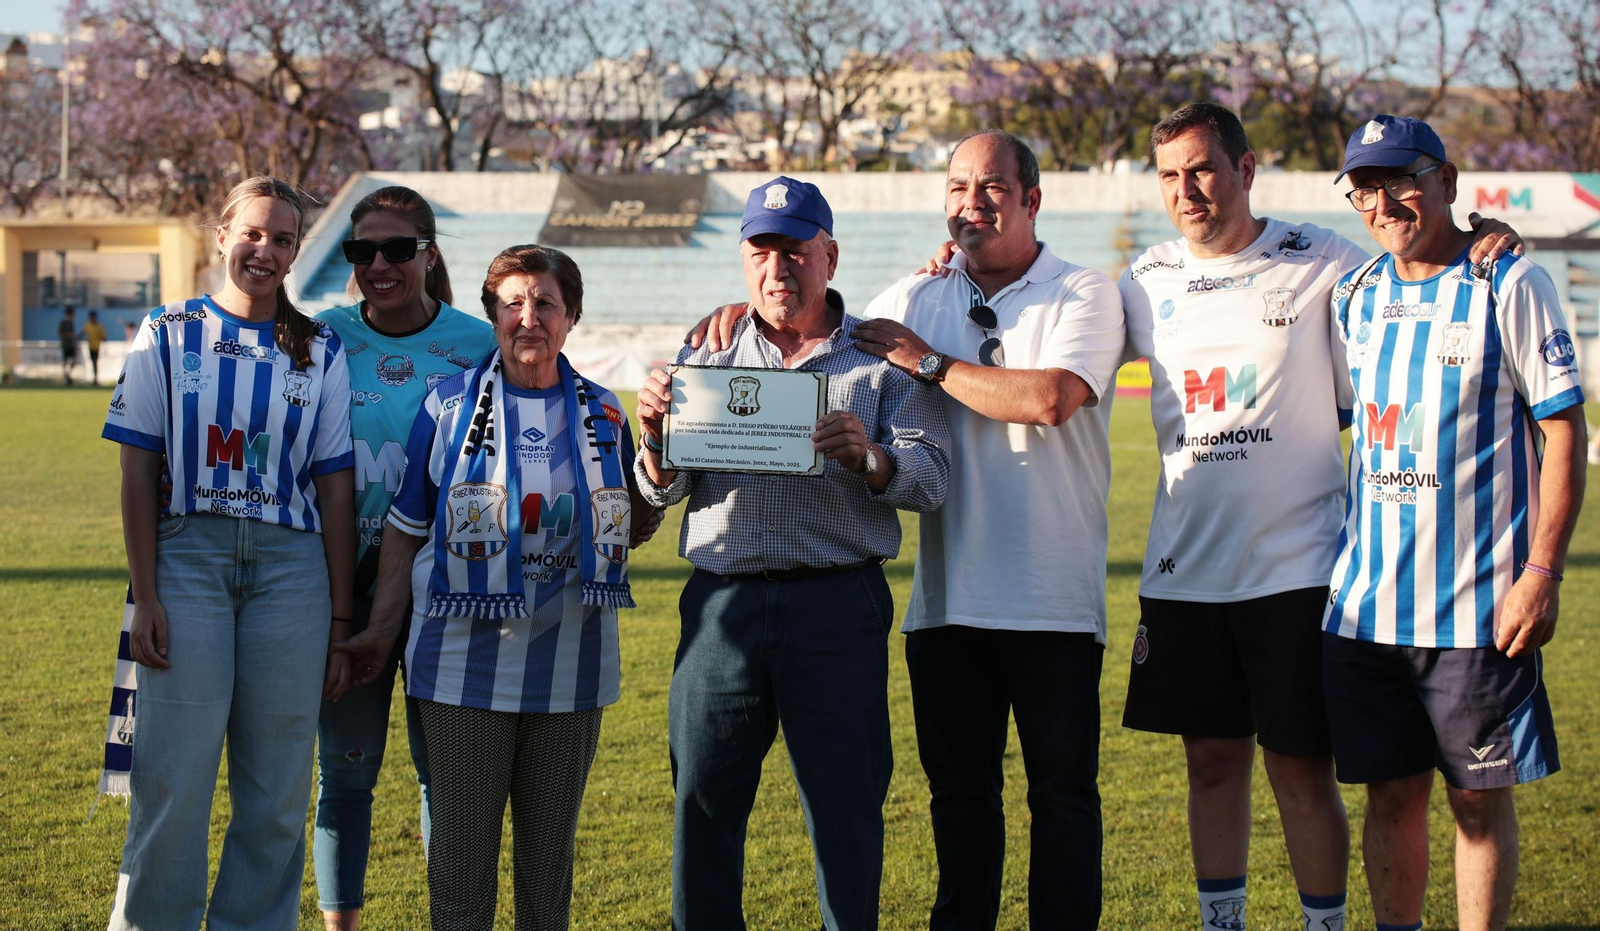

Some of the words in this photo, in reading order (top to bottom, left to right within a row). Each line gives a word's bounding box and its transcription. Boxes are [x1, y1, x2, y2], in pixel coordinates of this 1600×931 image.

[1187, 275, 1257, 293] adecosur
[1382, 301, 1441, 319] adecosur
[213, 339, 279, 361] adecosur
[1184, 364, 1257, 413] MM
[1366, 403, 1427, 452] MM
[1176, 426, 1273, 448] MundoMÓVIL
[513, 444, 555, 452] OCIOPLAY
[1192, 447, 1248, 463] Network
[193, 486, 283, 506] MundoMÓVIL
[1371, 488, 1416, 503] Network
[211, 501, 262, 517] Network
